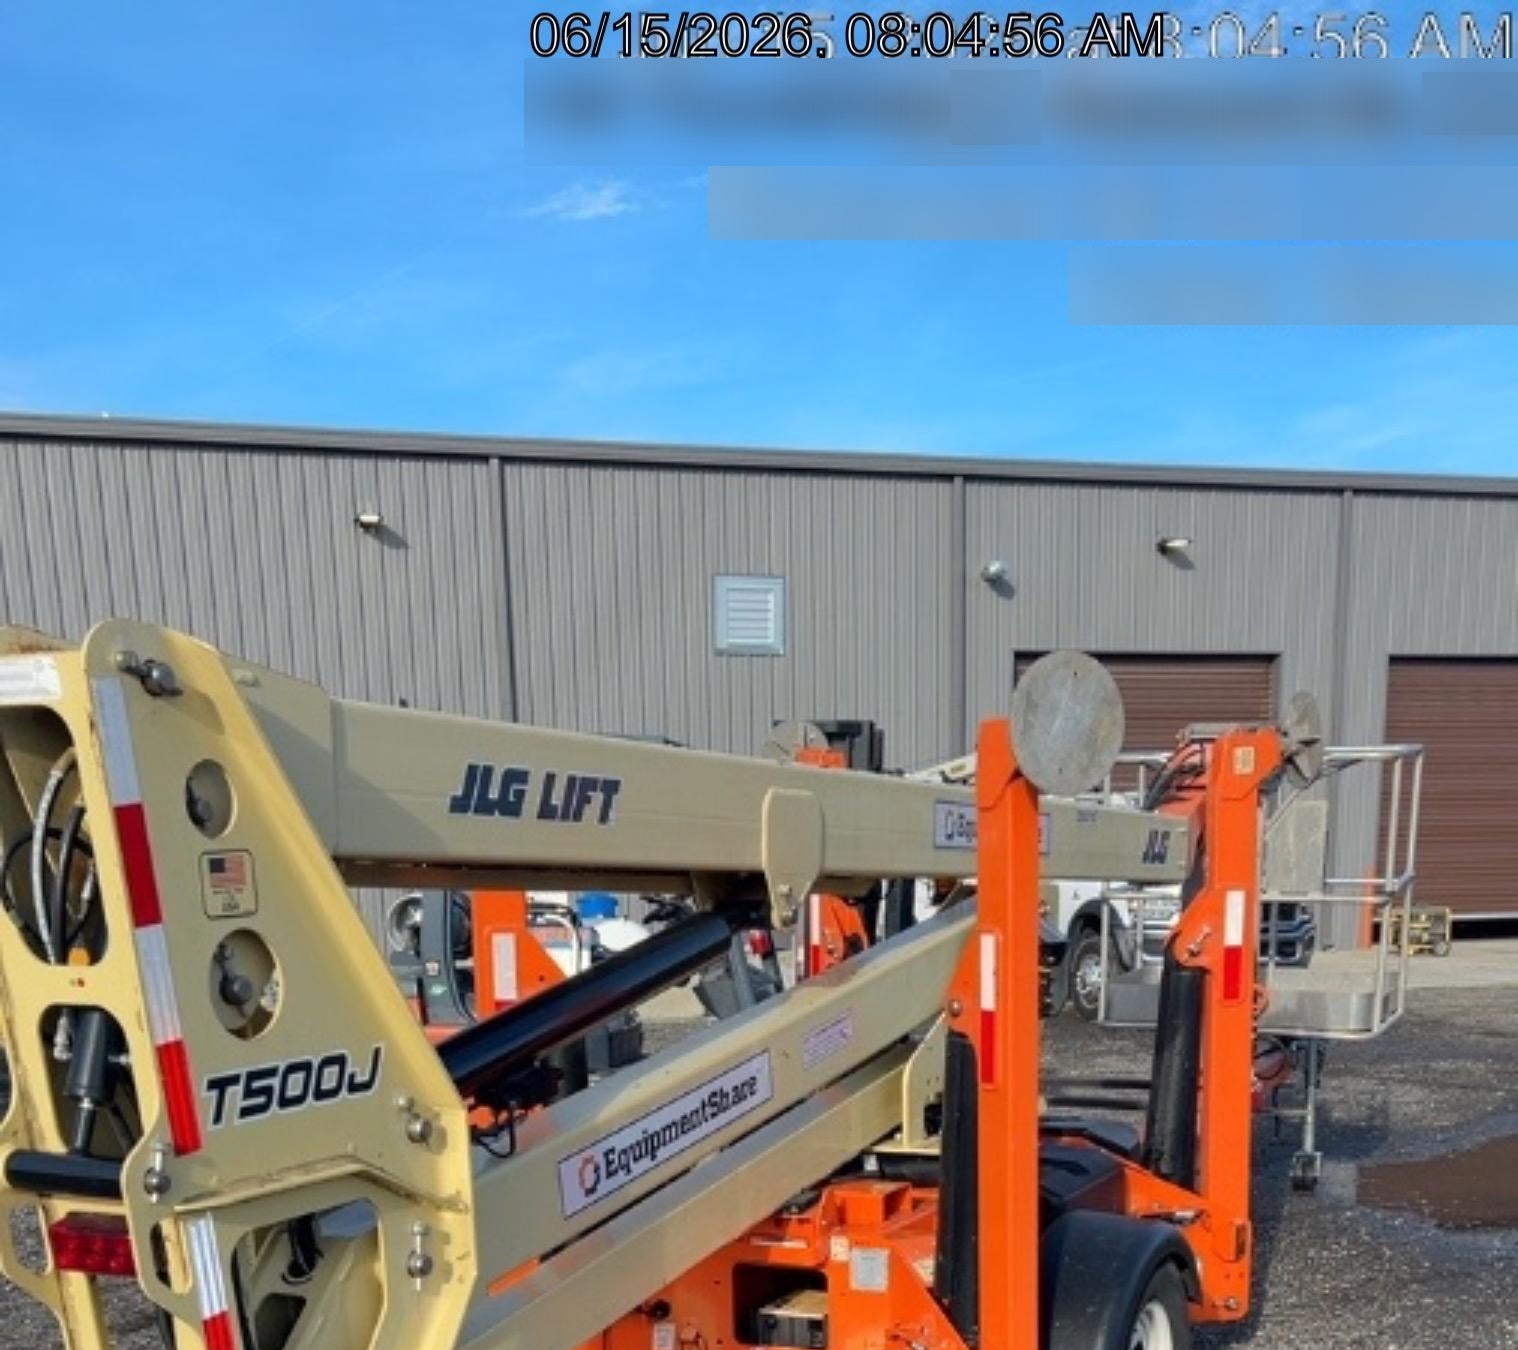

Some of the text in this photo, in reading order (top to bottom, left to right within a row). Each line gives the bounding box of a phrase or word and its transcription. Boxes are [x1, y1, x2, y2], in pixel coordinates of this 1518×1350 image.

[449, 762, 622, 826] JLG LIFT
[206, 1046, 383, 1127] T500J
[602, 1075, 758, 1181] EquipmentShare
